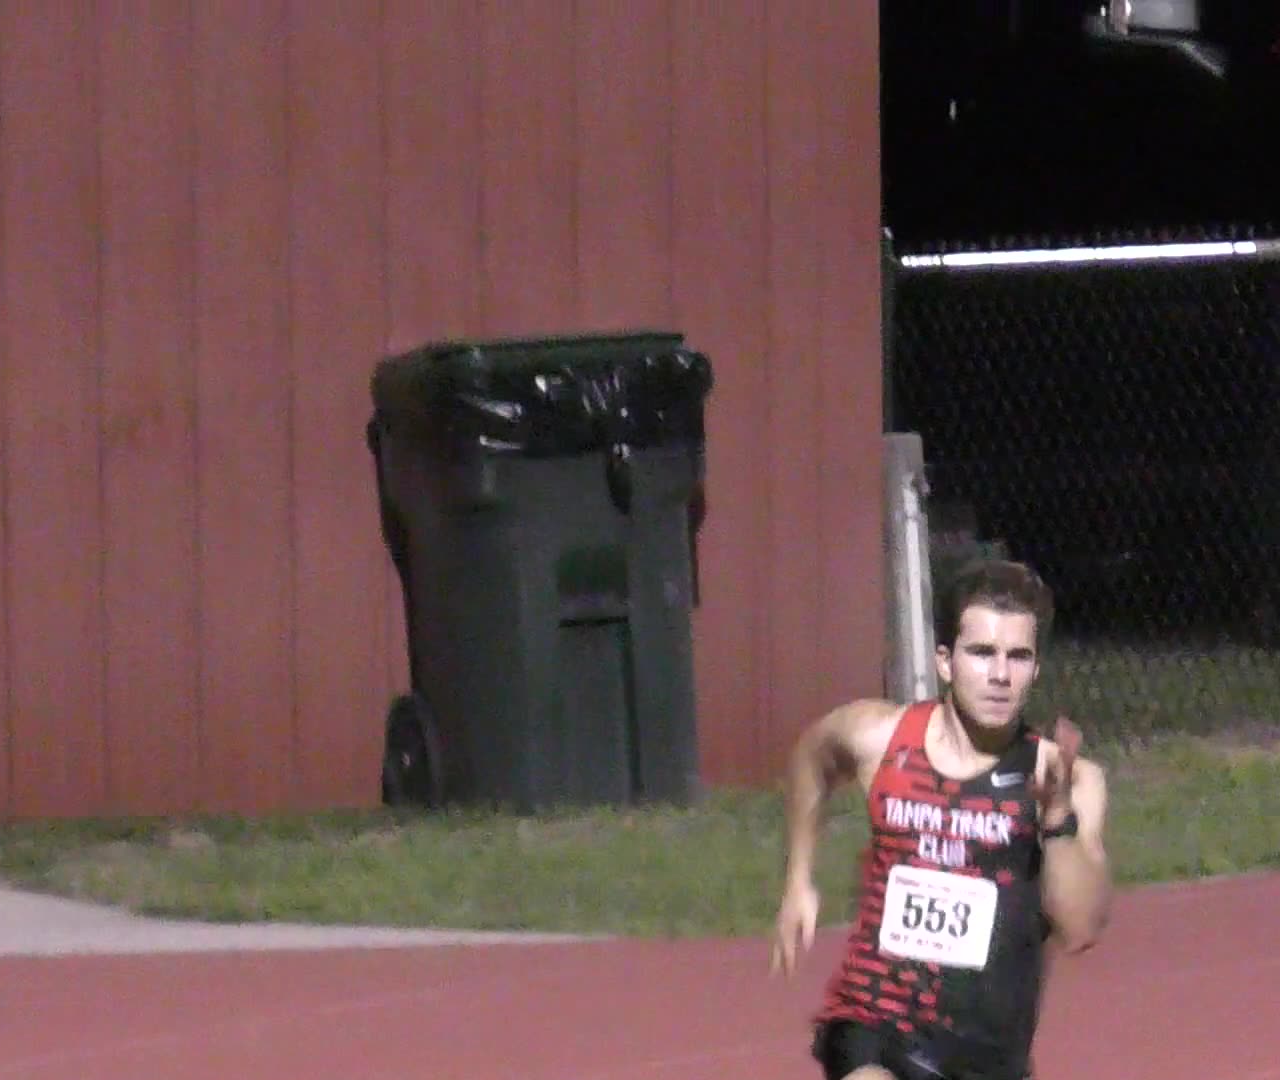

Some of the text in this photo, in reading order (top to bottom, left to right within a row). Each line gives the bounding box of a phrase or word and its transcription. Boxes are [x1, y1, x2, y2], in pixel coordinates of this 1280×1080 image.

[885, 797, 1012, 847] TAMPA TRACK
[918, 832, 967, 867] CLUB
[902, 892, 972, 938] 553
